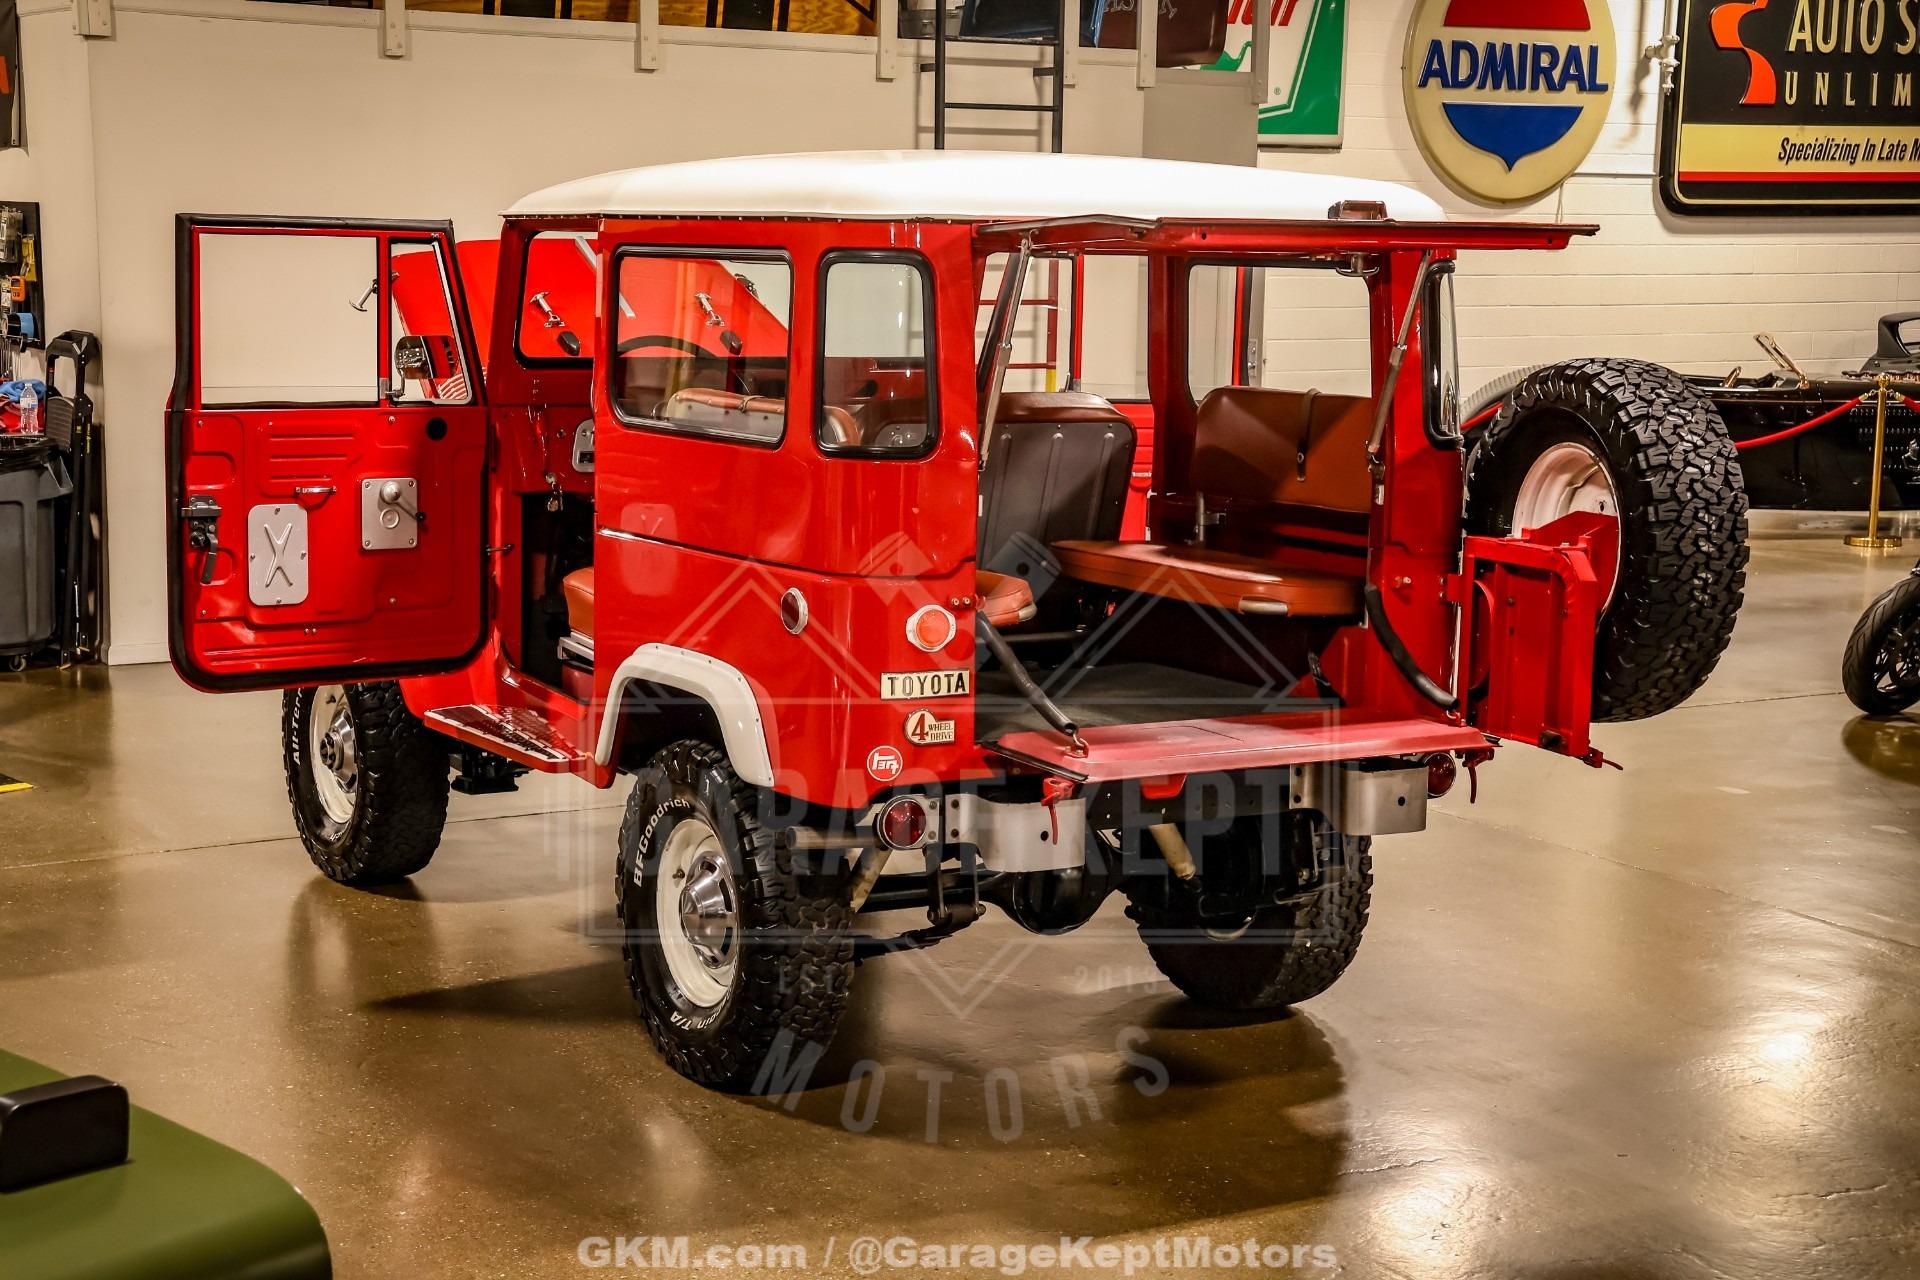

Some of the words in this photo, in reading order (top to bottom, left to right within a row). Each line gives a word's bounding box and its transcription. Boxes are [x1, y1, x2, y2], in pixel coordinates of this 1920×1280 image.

[1896, 0, 1920, 55] S
[1418, 39, 1609, 92] ADMIRAL
[1784, 71, 1912, 107] UNLIM
[1778, 137, 1860, 165] Specializing
[1861, 138, 1876, 161] In
[1877, 138, 1908, 161] Late
[888, 673, 966, 697] TOYOTA
[911, 713, 929, 740] 4
[928, 722, 953, 731] WHEEL
[930, 731, 953, 741] DRIVE
[633, 797, 691, 888] BFGoodrich
